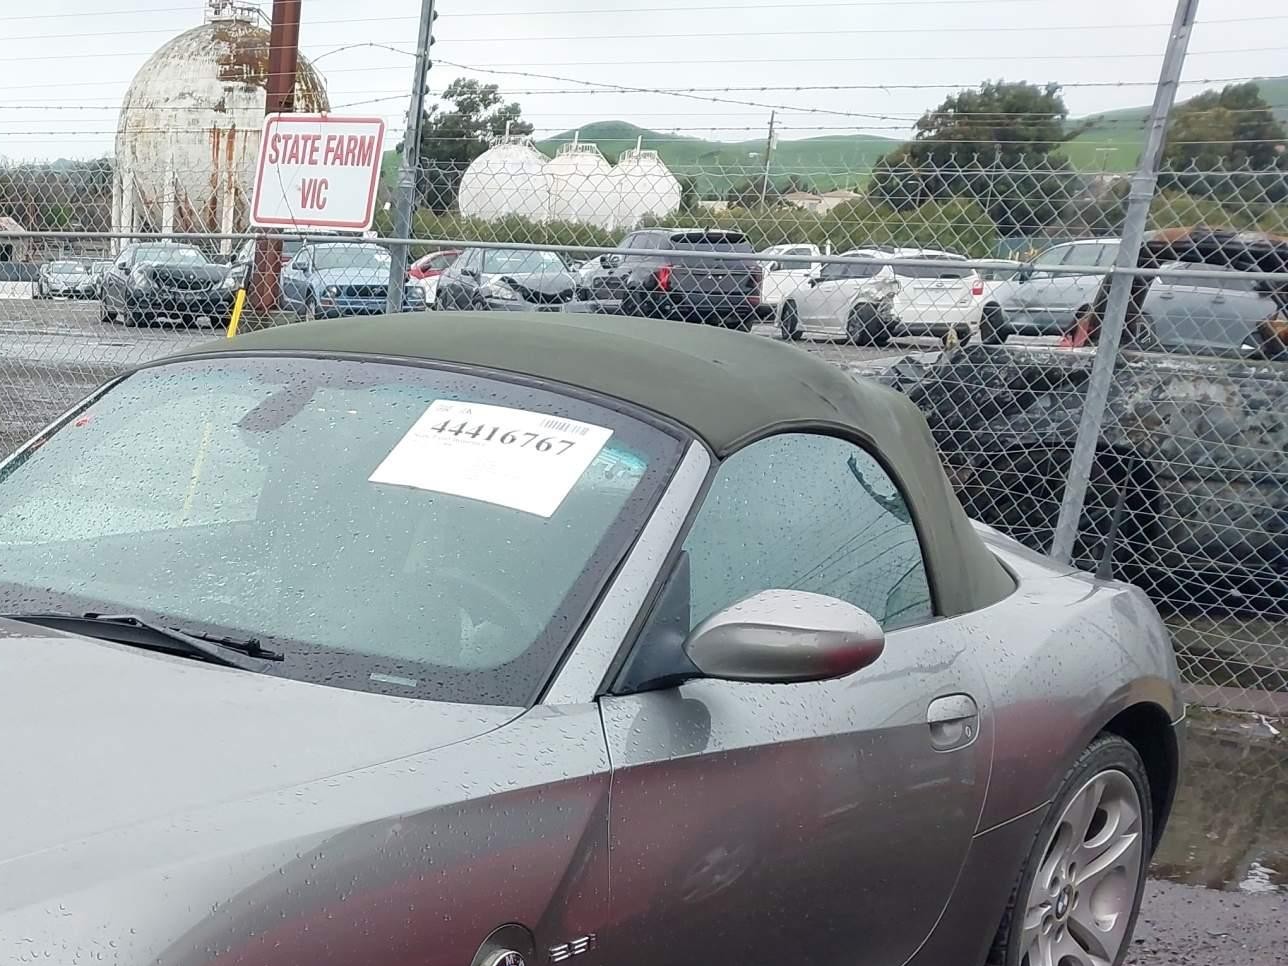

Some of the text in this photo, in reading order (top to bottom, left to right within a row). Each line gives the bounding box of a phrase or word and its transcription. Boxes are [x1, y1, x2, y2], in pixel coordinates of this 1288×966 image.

[269, 133, 375, 167] STATE FARM
[301, 178, 328, 209] VIC
[432, 420, 575, 455] 44416767
